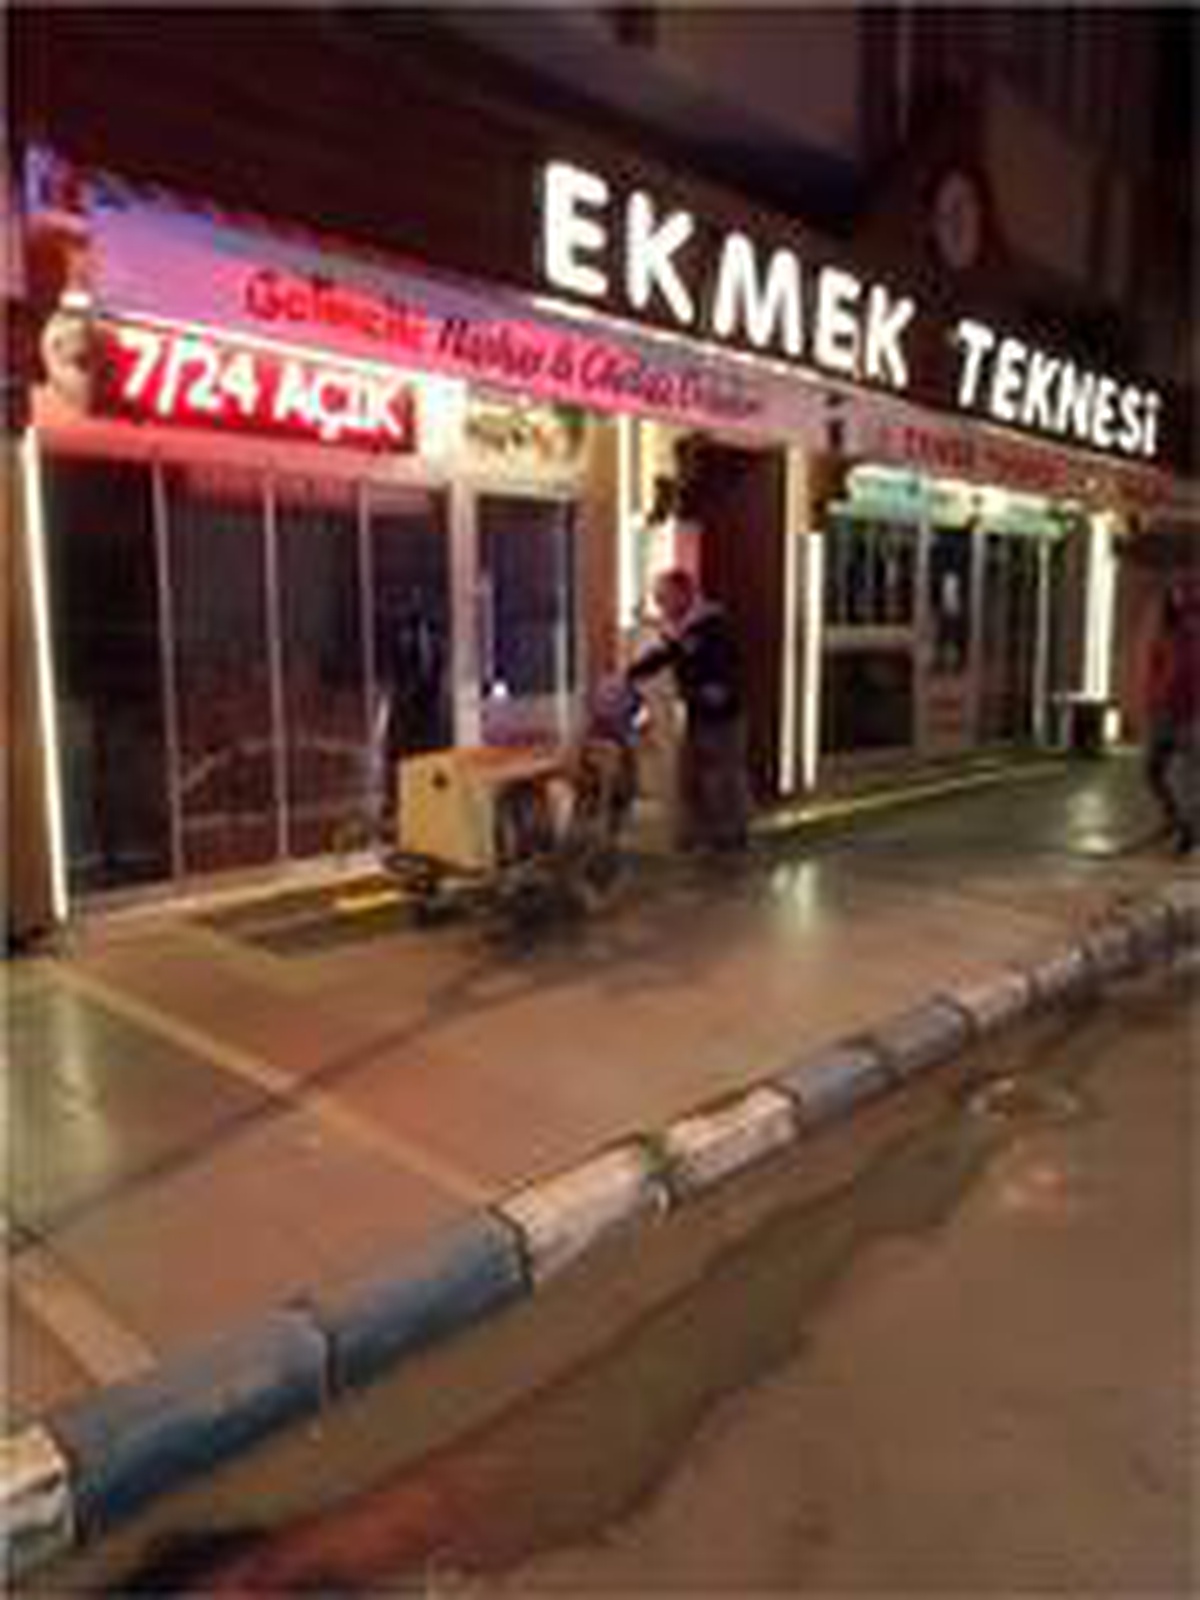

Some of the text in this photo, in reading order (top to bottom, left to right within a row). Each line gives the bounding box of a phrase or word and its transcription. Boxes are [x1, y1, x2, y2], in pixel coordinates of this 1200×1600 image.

[542, 160, 917, 389] EKMEK
[118, 326, 403, 440] 7/24 AÇIK
